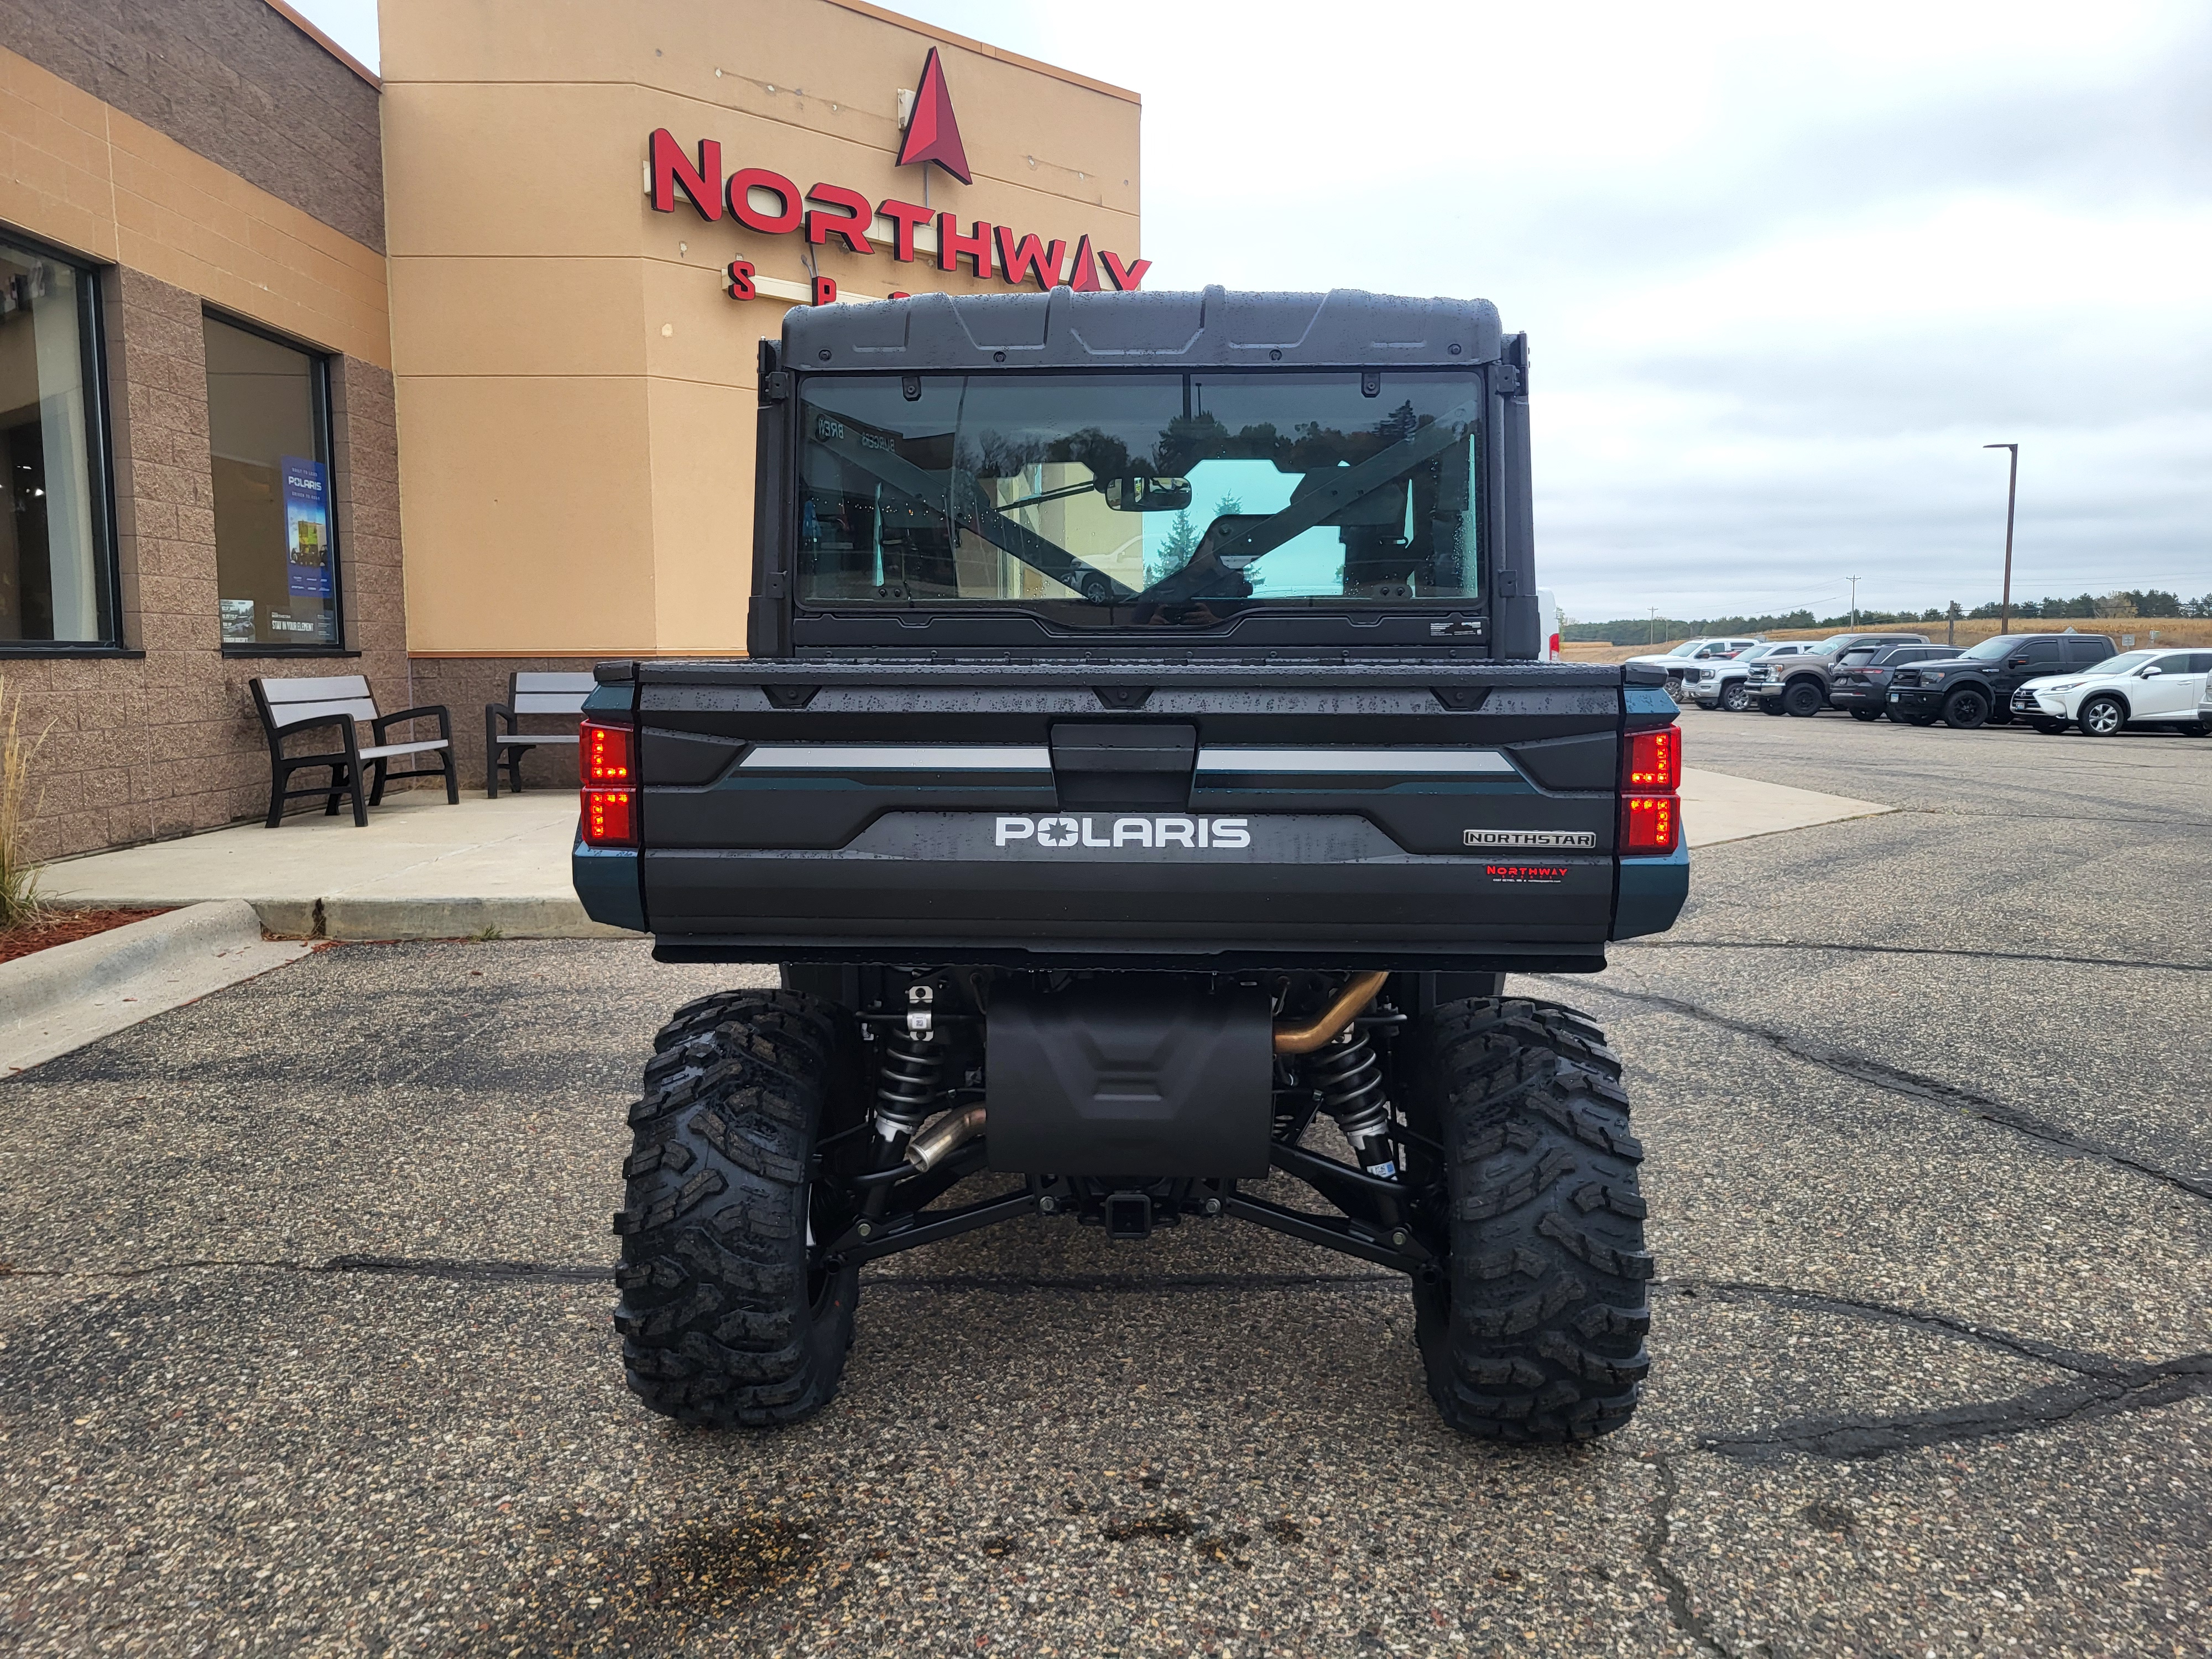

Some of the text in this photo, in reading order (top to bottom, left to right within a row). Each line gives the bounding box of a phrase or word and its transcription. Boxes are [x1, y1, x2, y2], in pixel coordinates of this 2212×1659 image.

[288, 476, 322, 491] POLARIS
[272, 620, 281, 630] STAY
[282, 621, 287, 630] IN
[287, 621, 297, 630] YOUR
[298, 622, 314, 632] ELEMENT
[995, 817, 1250, 848] POLARIS
[1469, 833, 1590, 846] NORTHSTAR
[1486, 865, 1568, 876] NORTHWAY
